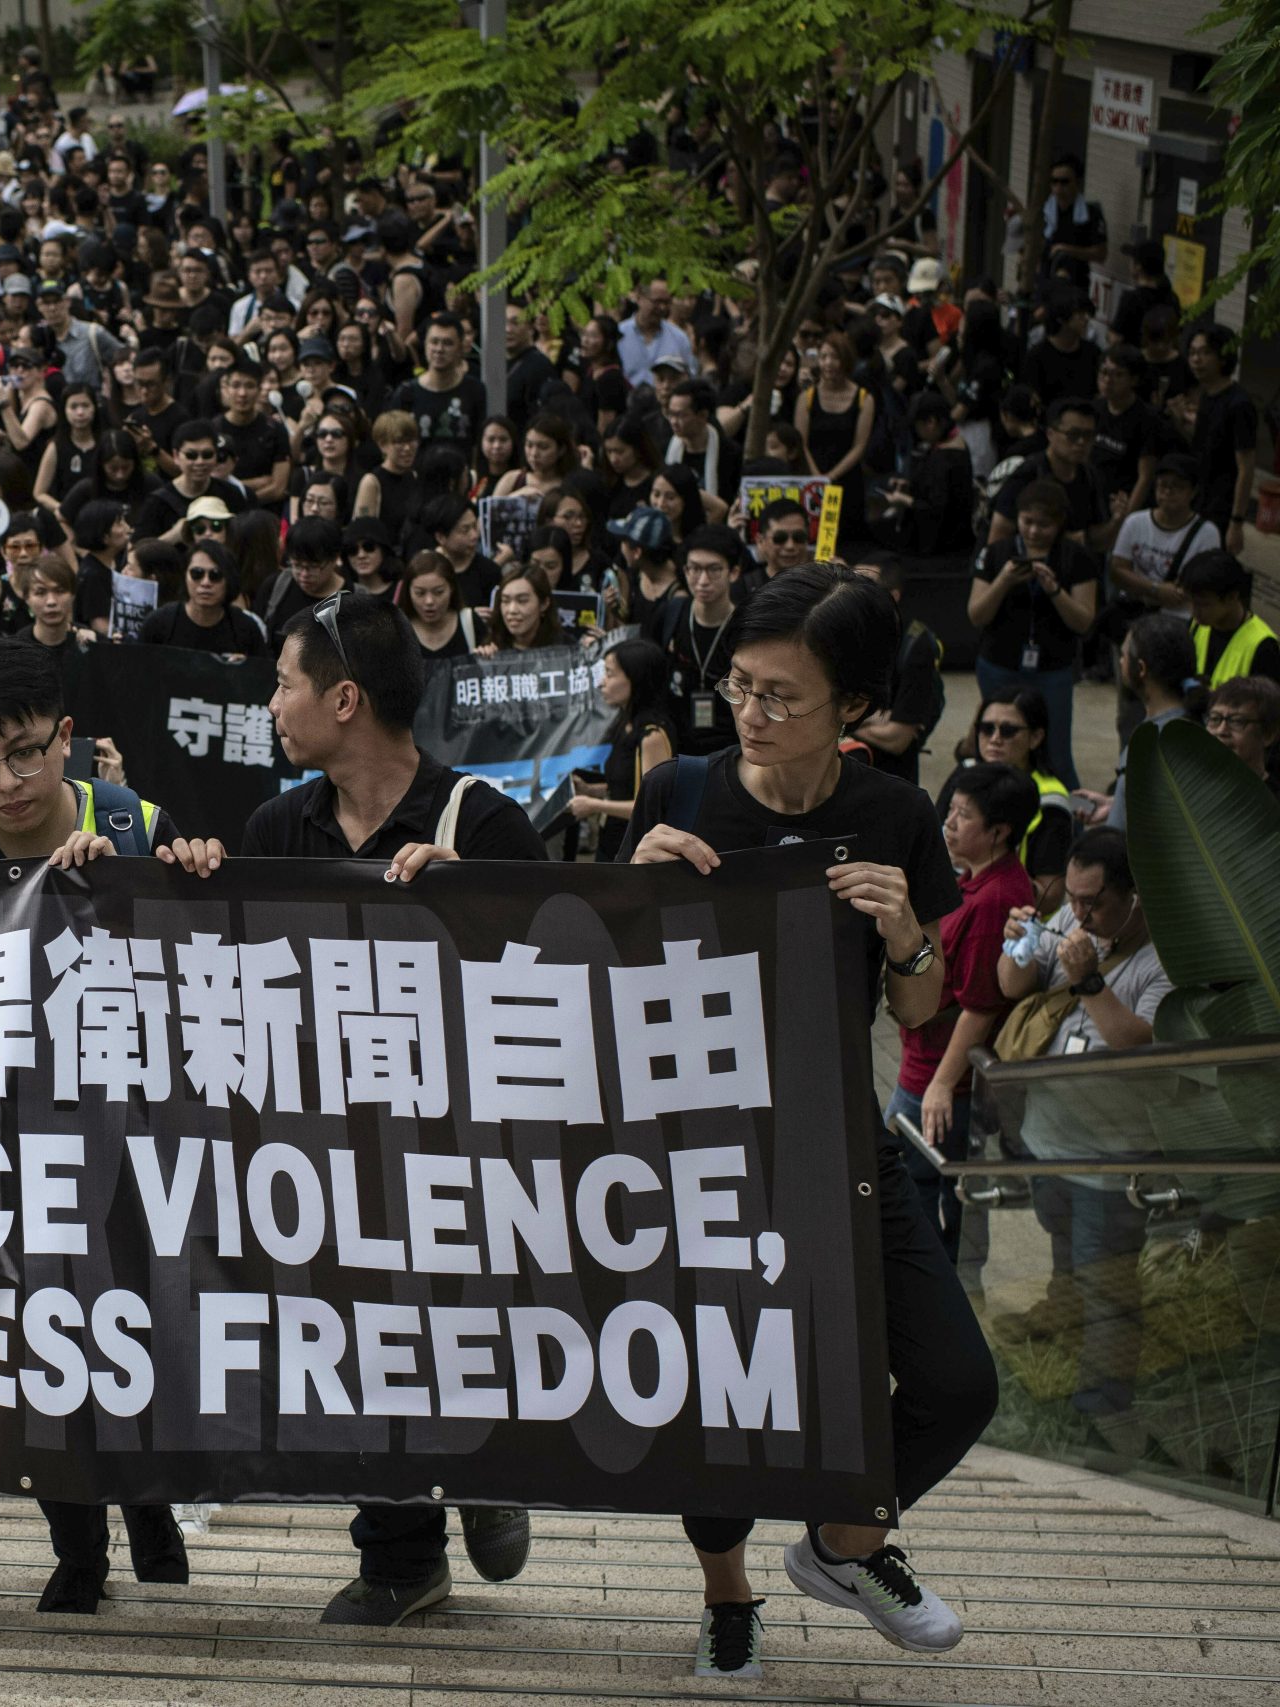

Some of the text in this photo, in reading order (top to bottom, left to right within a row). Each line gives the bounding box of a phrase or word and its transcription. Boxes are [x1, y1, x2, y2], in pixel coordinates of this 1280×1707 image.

[1092, 105, 1151, 137] NO SMOKING
[125, 1136, 786, 1286] VIOLENCE,
[199, 1293, 801, 1432] FREEDOM
